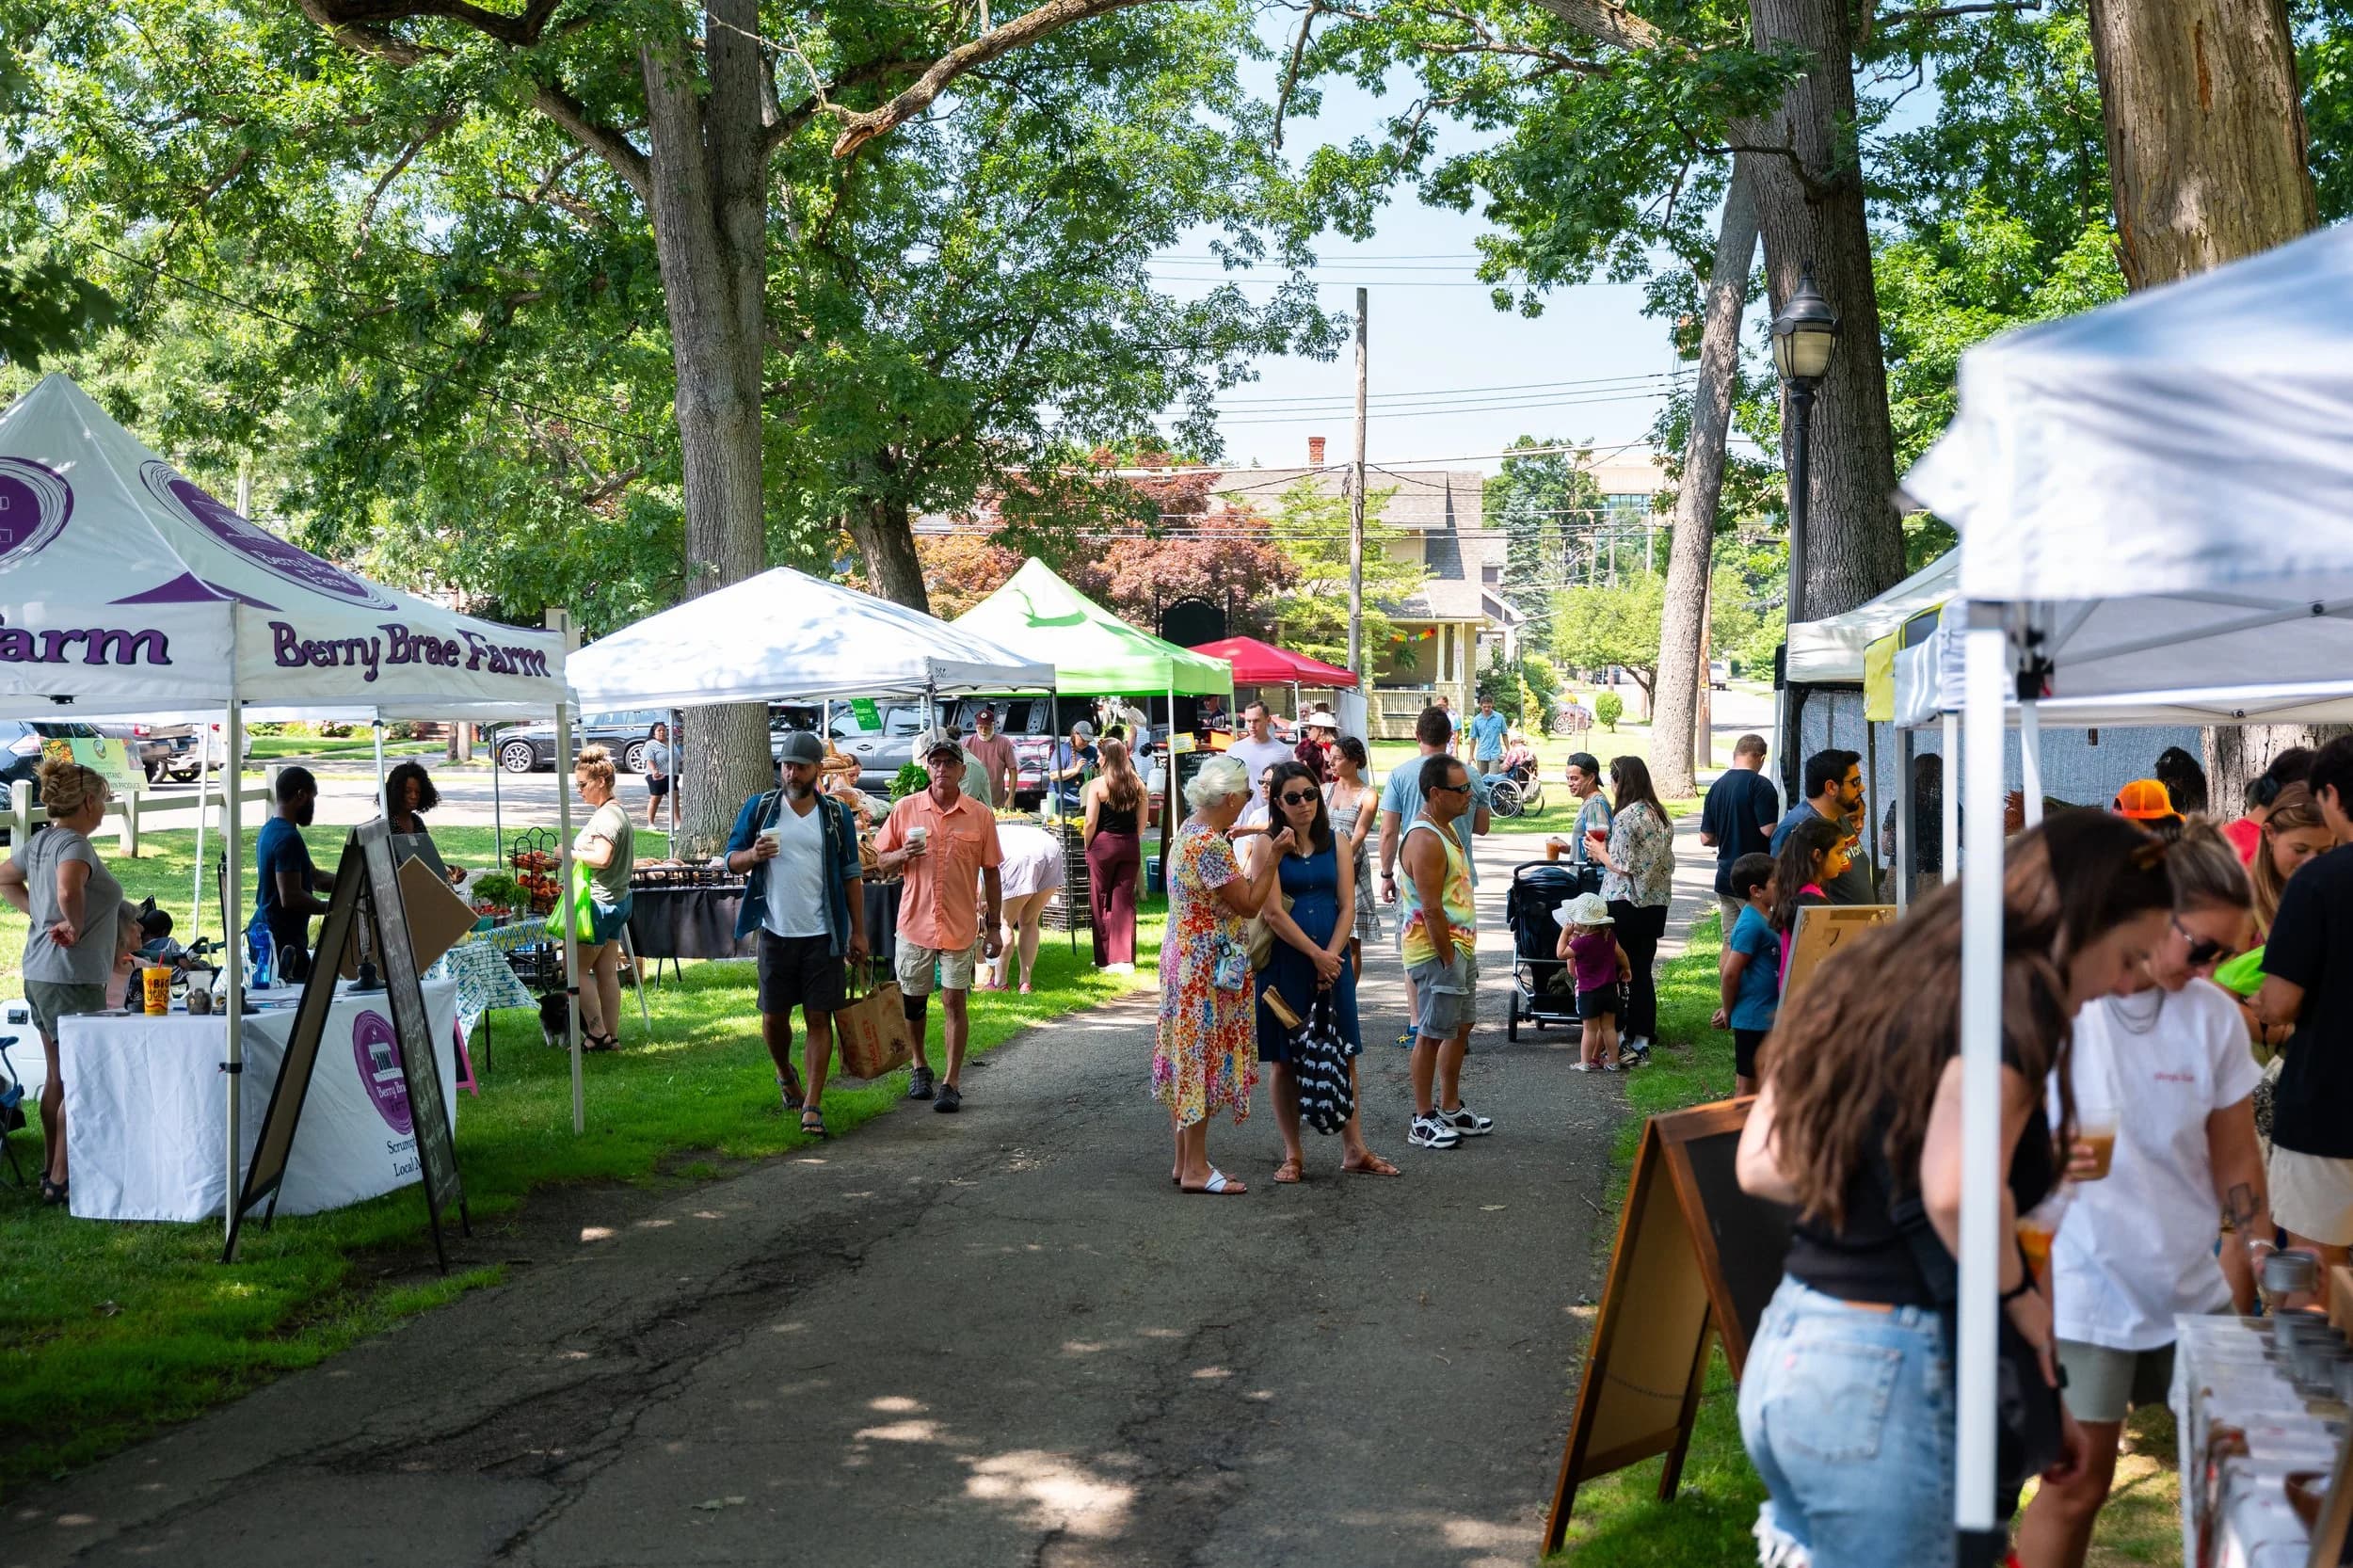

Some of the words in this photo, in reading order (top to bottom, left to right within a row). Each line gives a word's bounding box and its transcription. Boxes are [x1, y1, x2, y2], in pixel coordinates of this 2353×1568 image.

[0, 614, 173, 664] arm
[267, 621, 380, 682] Berry
[377, 622, 460, 667] Brae
[456, 627, 552, 678] Farm
[376, 1083, 398, 1099] Berry
[393, 1157, 415, 1177] Local
